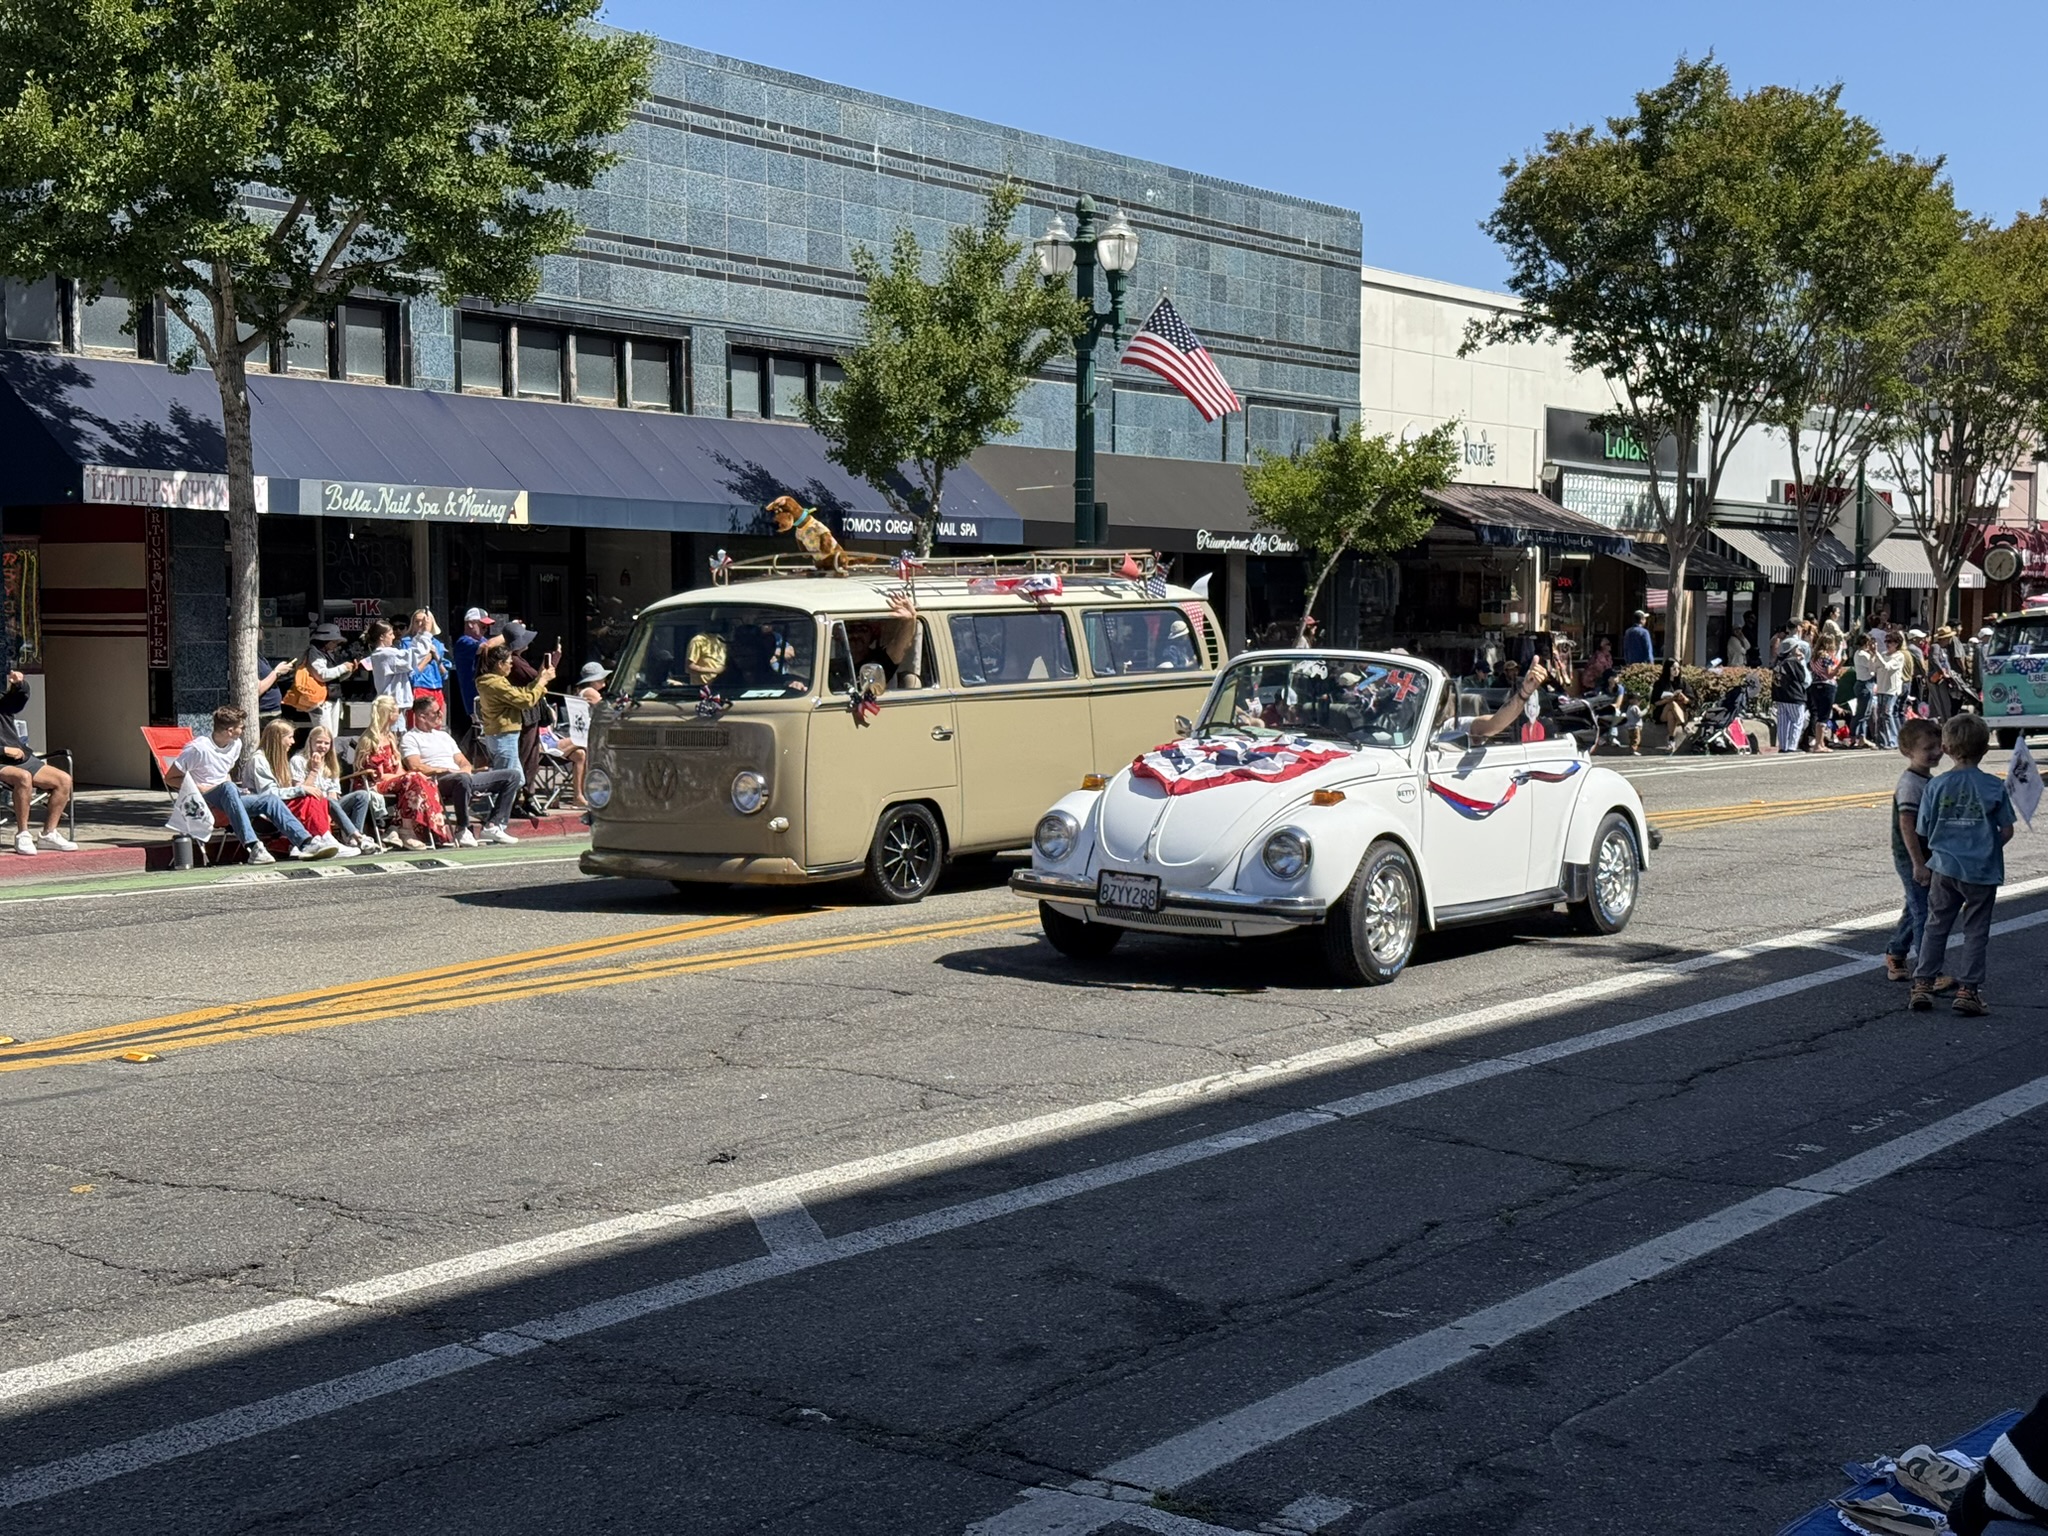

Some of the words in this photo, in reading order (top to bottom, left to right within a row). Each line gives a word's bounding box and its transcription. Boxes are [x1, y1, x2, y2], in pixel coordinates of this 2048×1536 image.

[91, 473, 148, 502] LITTLE
[325, 484, 373, 513] Bella
[373, 486, 411, 514] Nail
[413, 492, 441, 519] Spa
[444, 491, 457, 515] &
[457, 493, 507, 523] Waxing
[842, 518, 881, 533] TOMO'S
[936, 522, 957, 536] NAIL
[960, 523, 978, 537] SPA
[1196, 529, 1250, 553] Triumphant
[351, 598, 382, 616] TK
[153, 594, 163, 658] TELLER
[1356, 664, 1421, 703] 74
[1101, 883, 1156, 907] 8ZYY288
